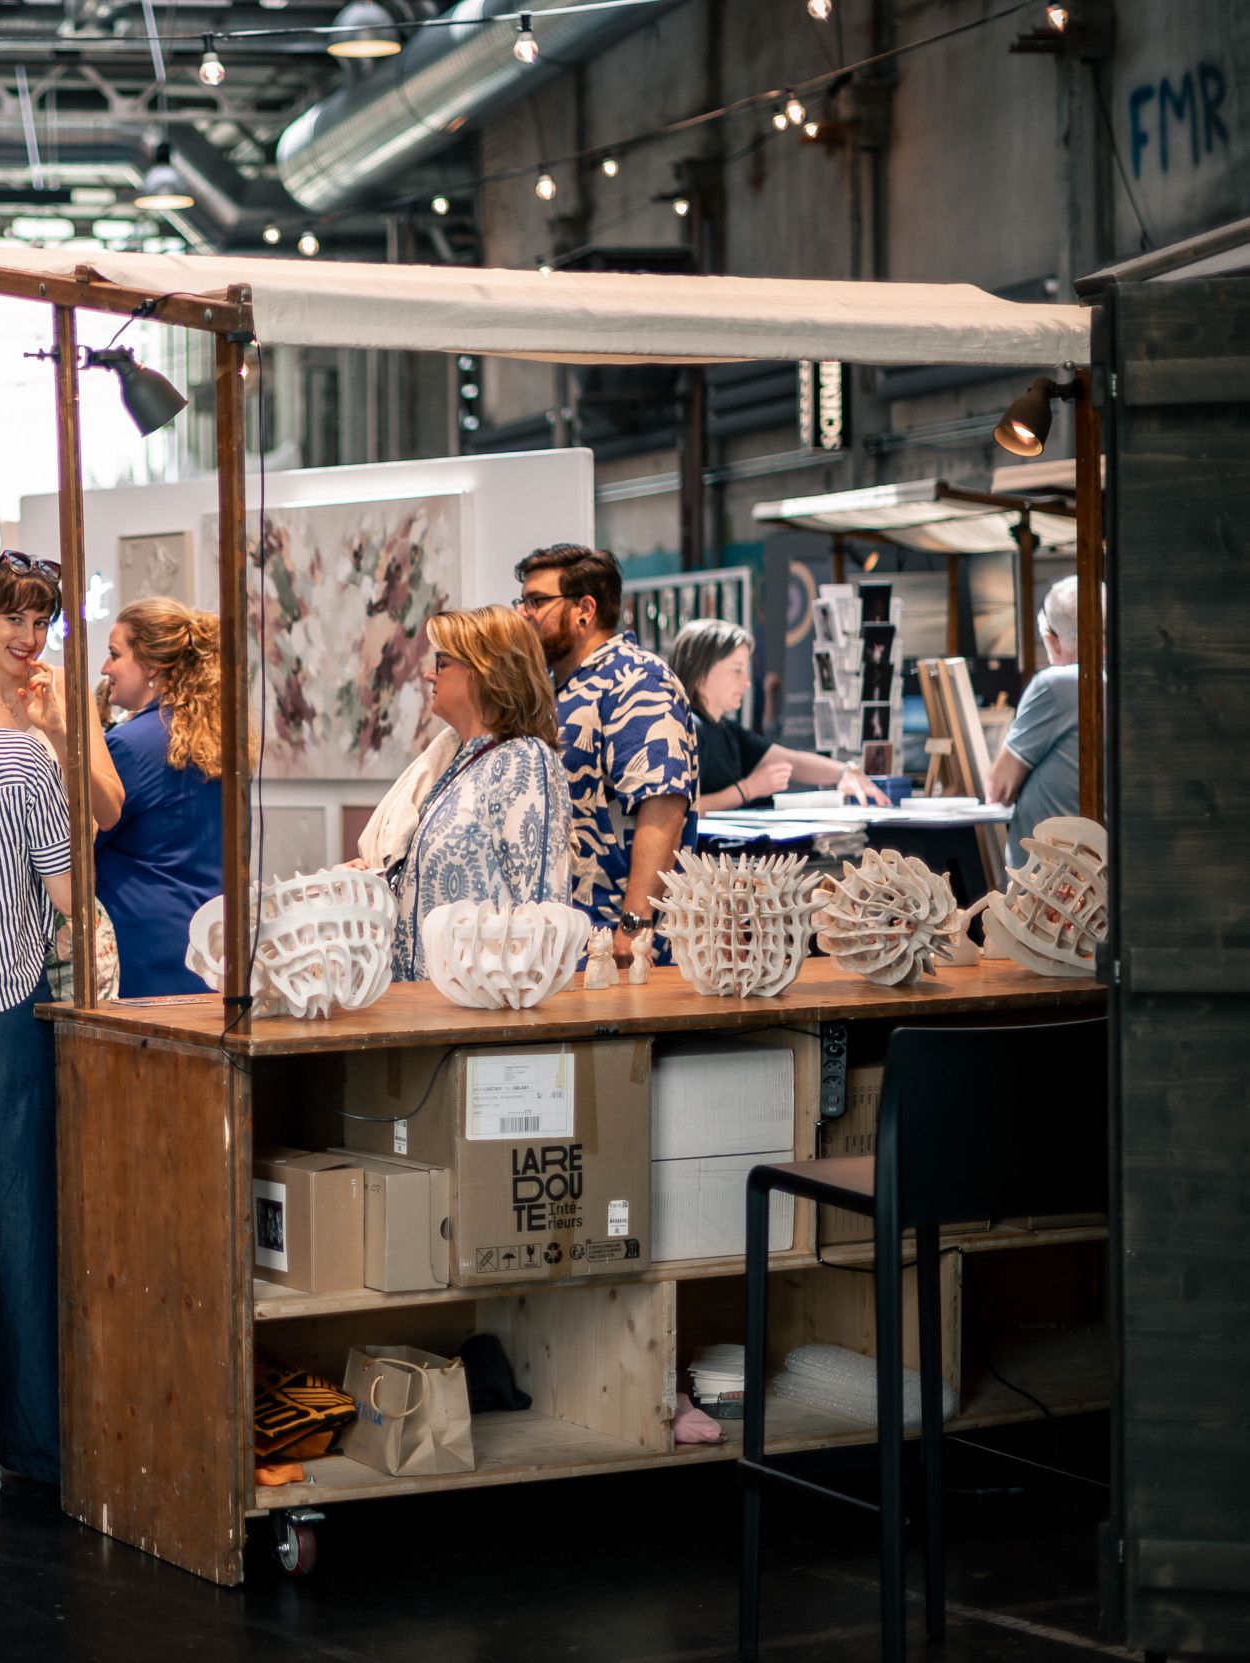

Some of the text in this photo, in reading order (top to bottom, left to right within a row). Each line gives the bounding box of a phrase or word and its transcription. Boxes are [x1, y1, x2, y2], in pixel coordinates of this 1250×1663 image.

[1129, 62, 1230, 181] FMR
[512, 1144, 582, 1175] LARE
[512, 1172, 582, 1204] DOU
[513, 1203, 546, 1232] TE
[548, 1216, 582, 1229] rieurs
